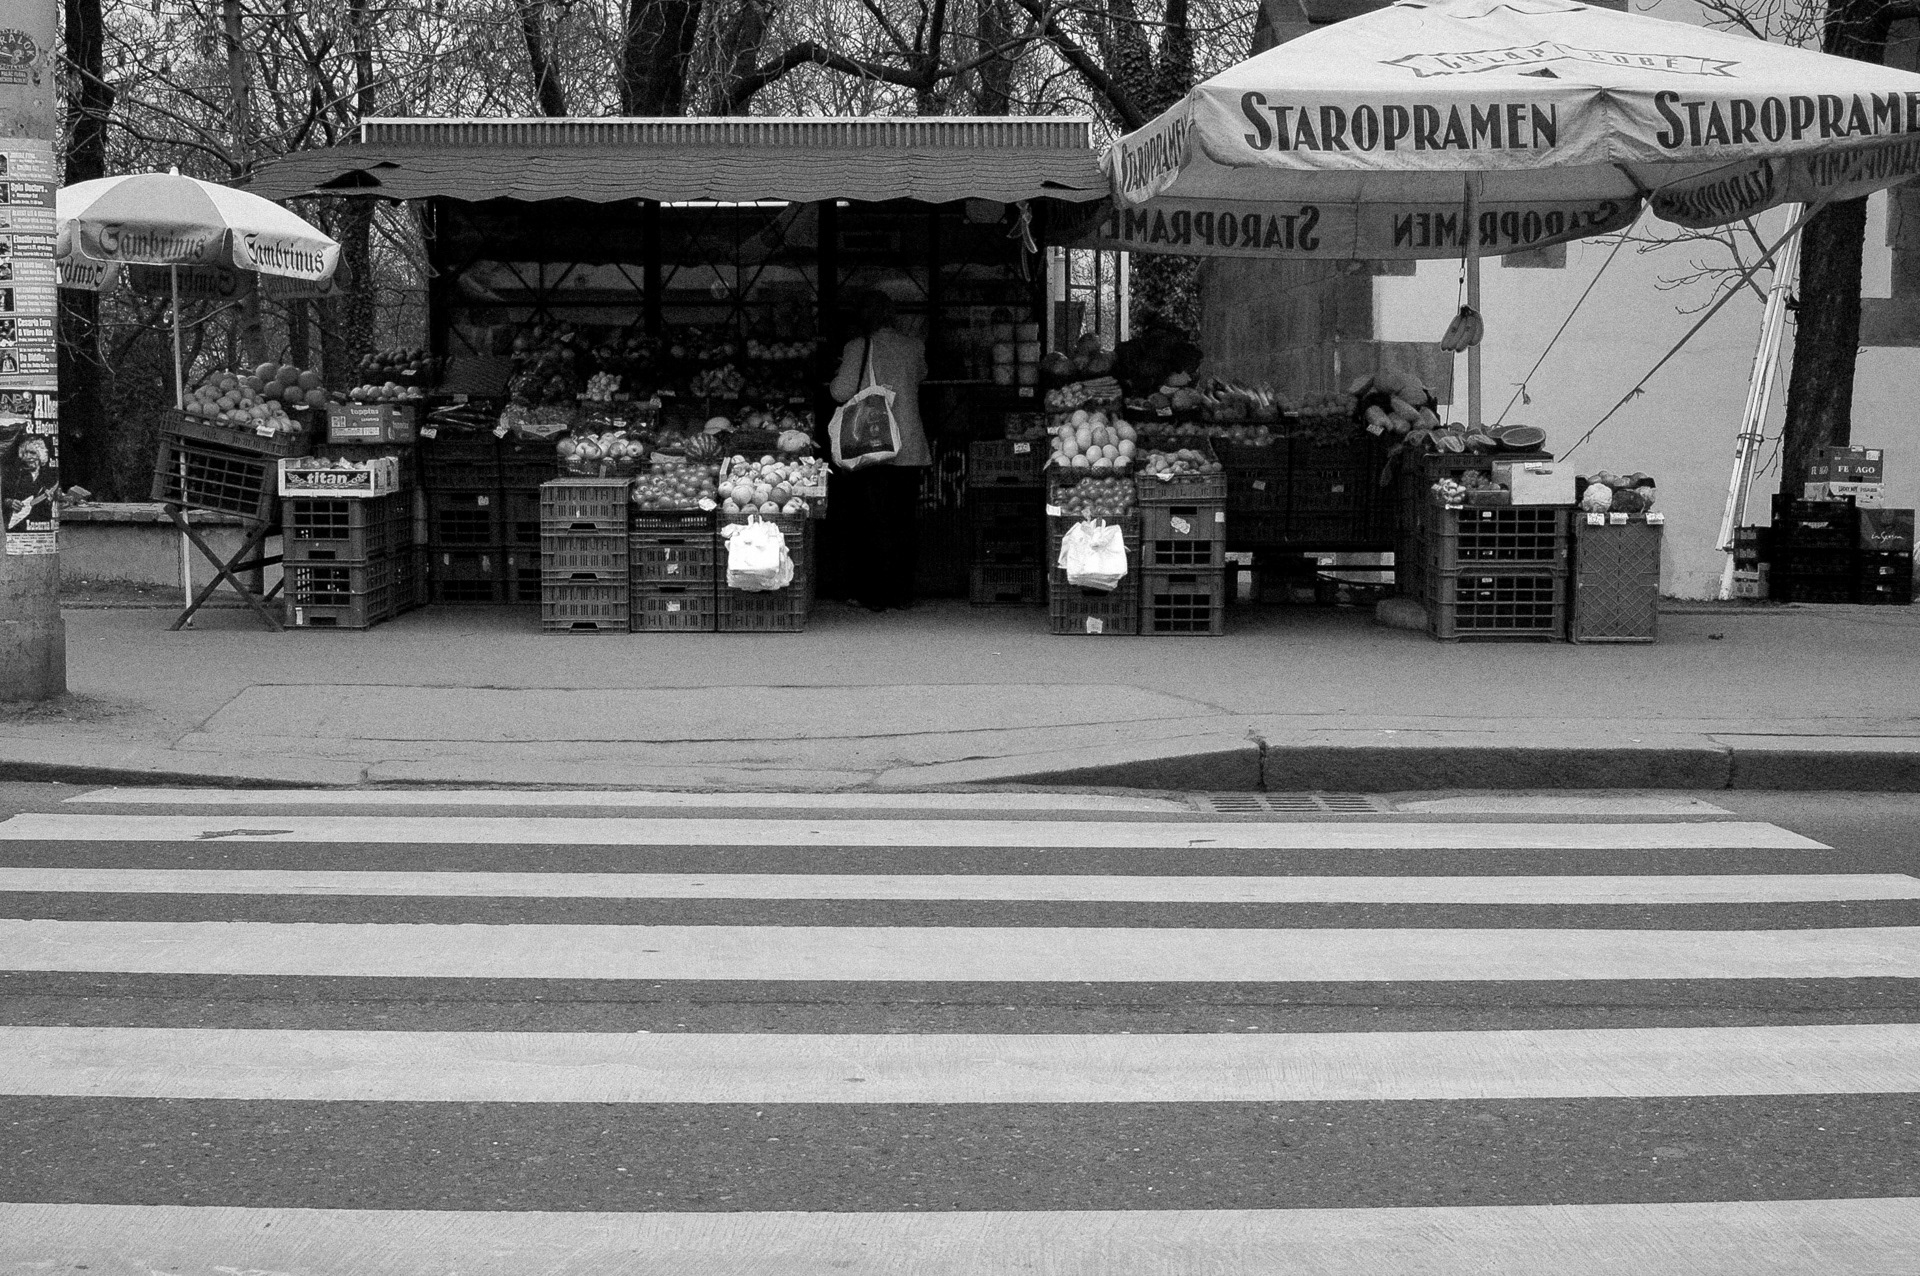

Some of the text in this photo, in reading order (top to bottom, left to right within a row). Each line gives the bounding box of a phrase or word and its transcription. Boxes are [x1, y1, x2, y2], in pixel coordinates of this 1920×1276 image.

[1240, 91, 1557, 153] STAROPRAMEN
[100, 221, 206, 257] Gambrinus
[244, 232, 324, 273] Gambrinus
[307, 472, 347, 484] titan
